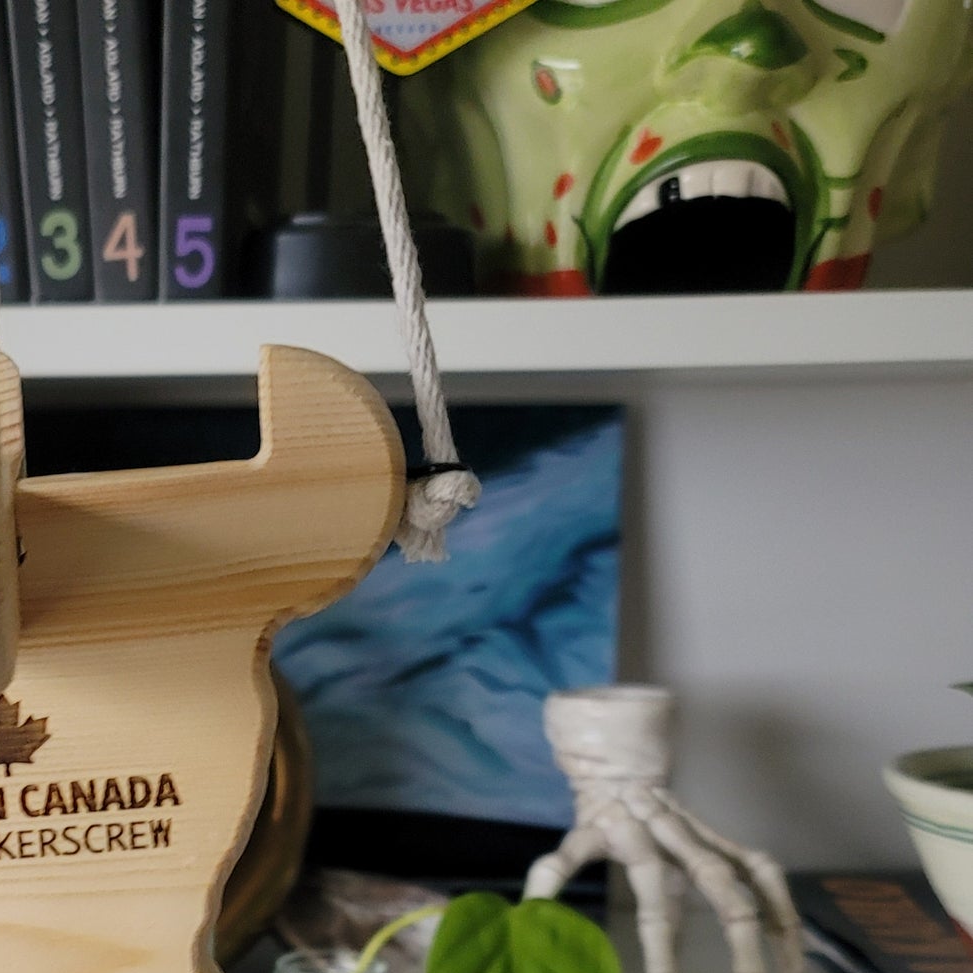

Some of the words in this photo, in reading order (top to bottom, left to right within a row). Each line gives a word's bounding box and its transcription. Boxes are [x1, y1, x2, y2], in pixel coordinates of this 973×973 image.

[38, 40, 56, 105] ADLARD
[104, 36, 122, 103] ADLARD
[190, 35, 206, 103] ADLARD
[44, 118, 63, 201] RATHBURN
[109, 116, 127, 199] RATHBURN
[188, 116, 204, 200] RATHBURN
[40, 210, 83, 282] 3
[102, 211, 146, 282] 4
[175, 215, 215, 289] 5
[19, 772, 182, 818] CANADA
